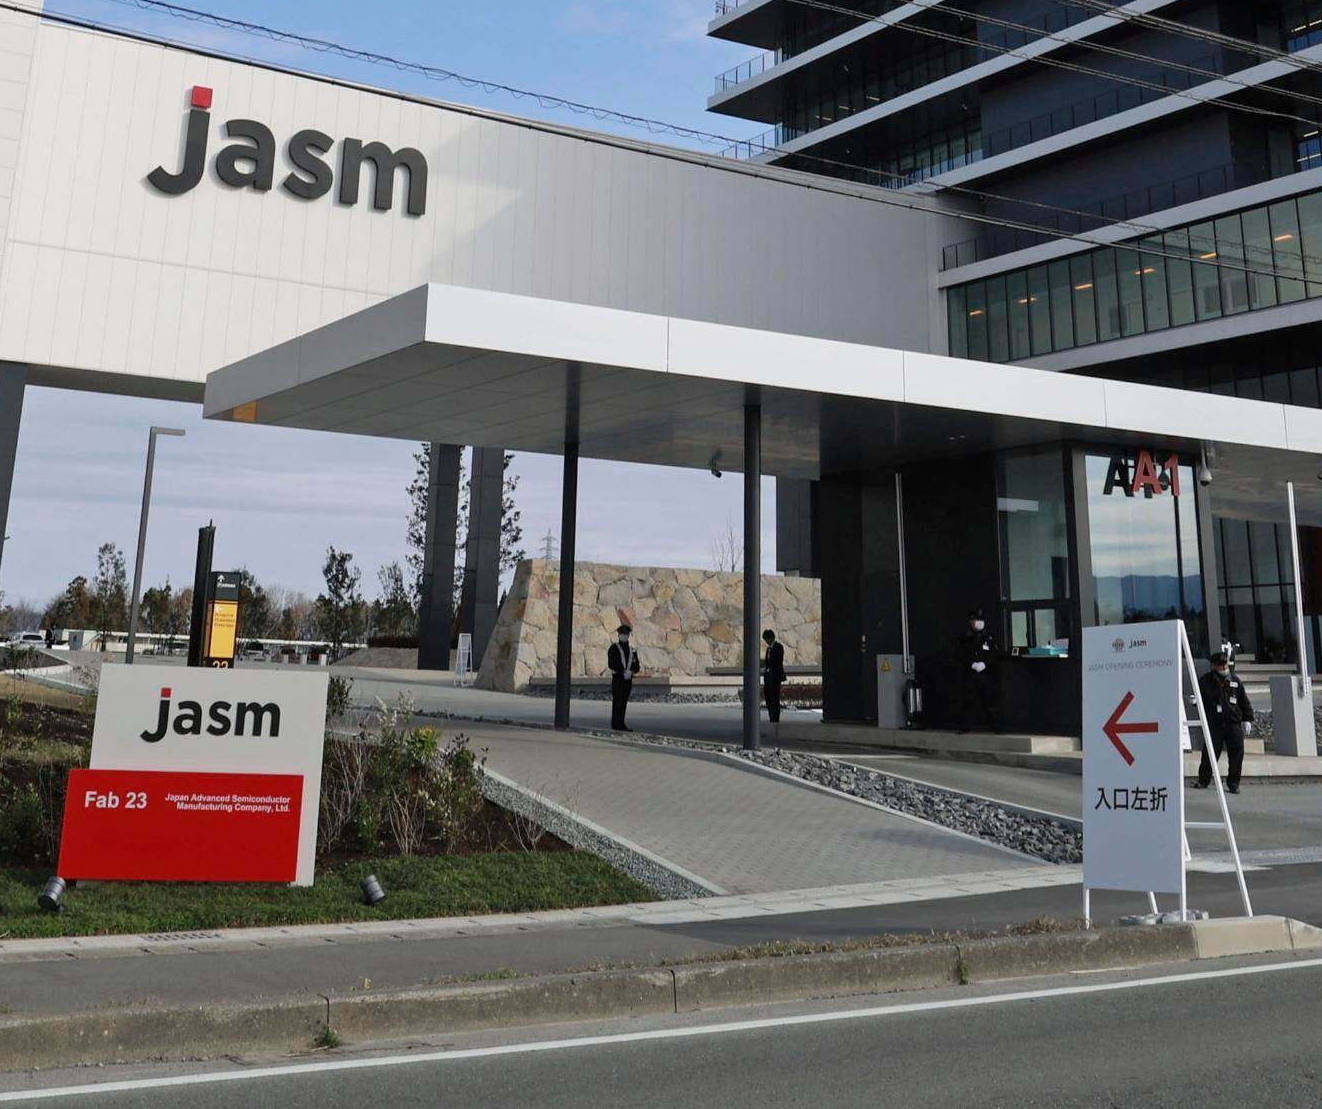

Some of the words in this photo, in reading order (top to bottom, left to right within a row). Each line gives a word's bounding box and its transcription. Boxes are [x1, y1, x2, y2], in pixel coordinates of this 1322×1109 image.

[146, 85, 429, 216] jasm
[1129, 639, 1147, 648] jasm
[1136, 658, 1173, 669] CEREMONY
[140, 687, 282, 743] jasm
[84, 790, 120, 809] Fab
[124, 791, 148, 810] 23
[165, 793, 189, 803] Japan
[191, 794, 230, 802] Advanced
[232, 795, 290, 803] Semiconductor
[1094, 787, 1168, 812] 入口左折
[177, 802, 233, 813] Manufacturing
[235, 803, 273, 813] Company,
[276, 804, 290, 812] Ltd.
